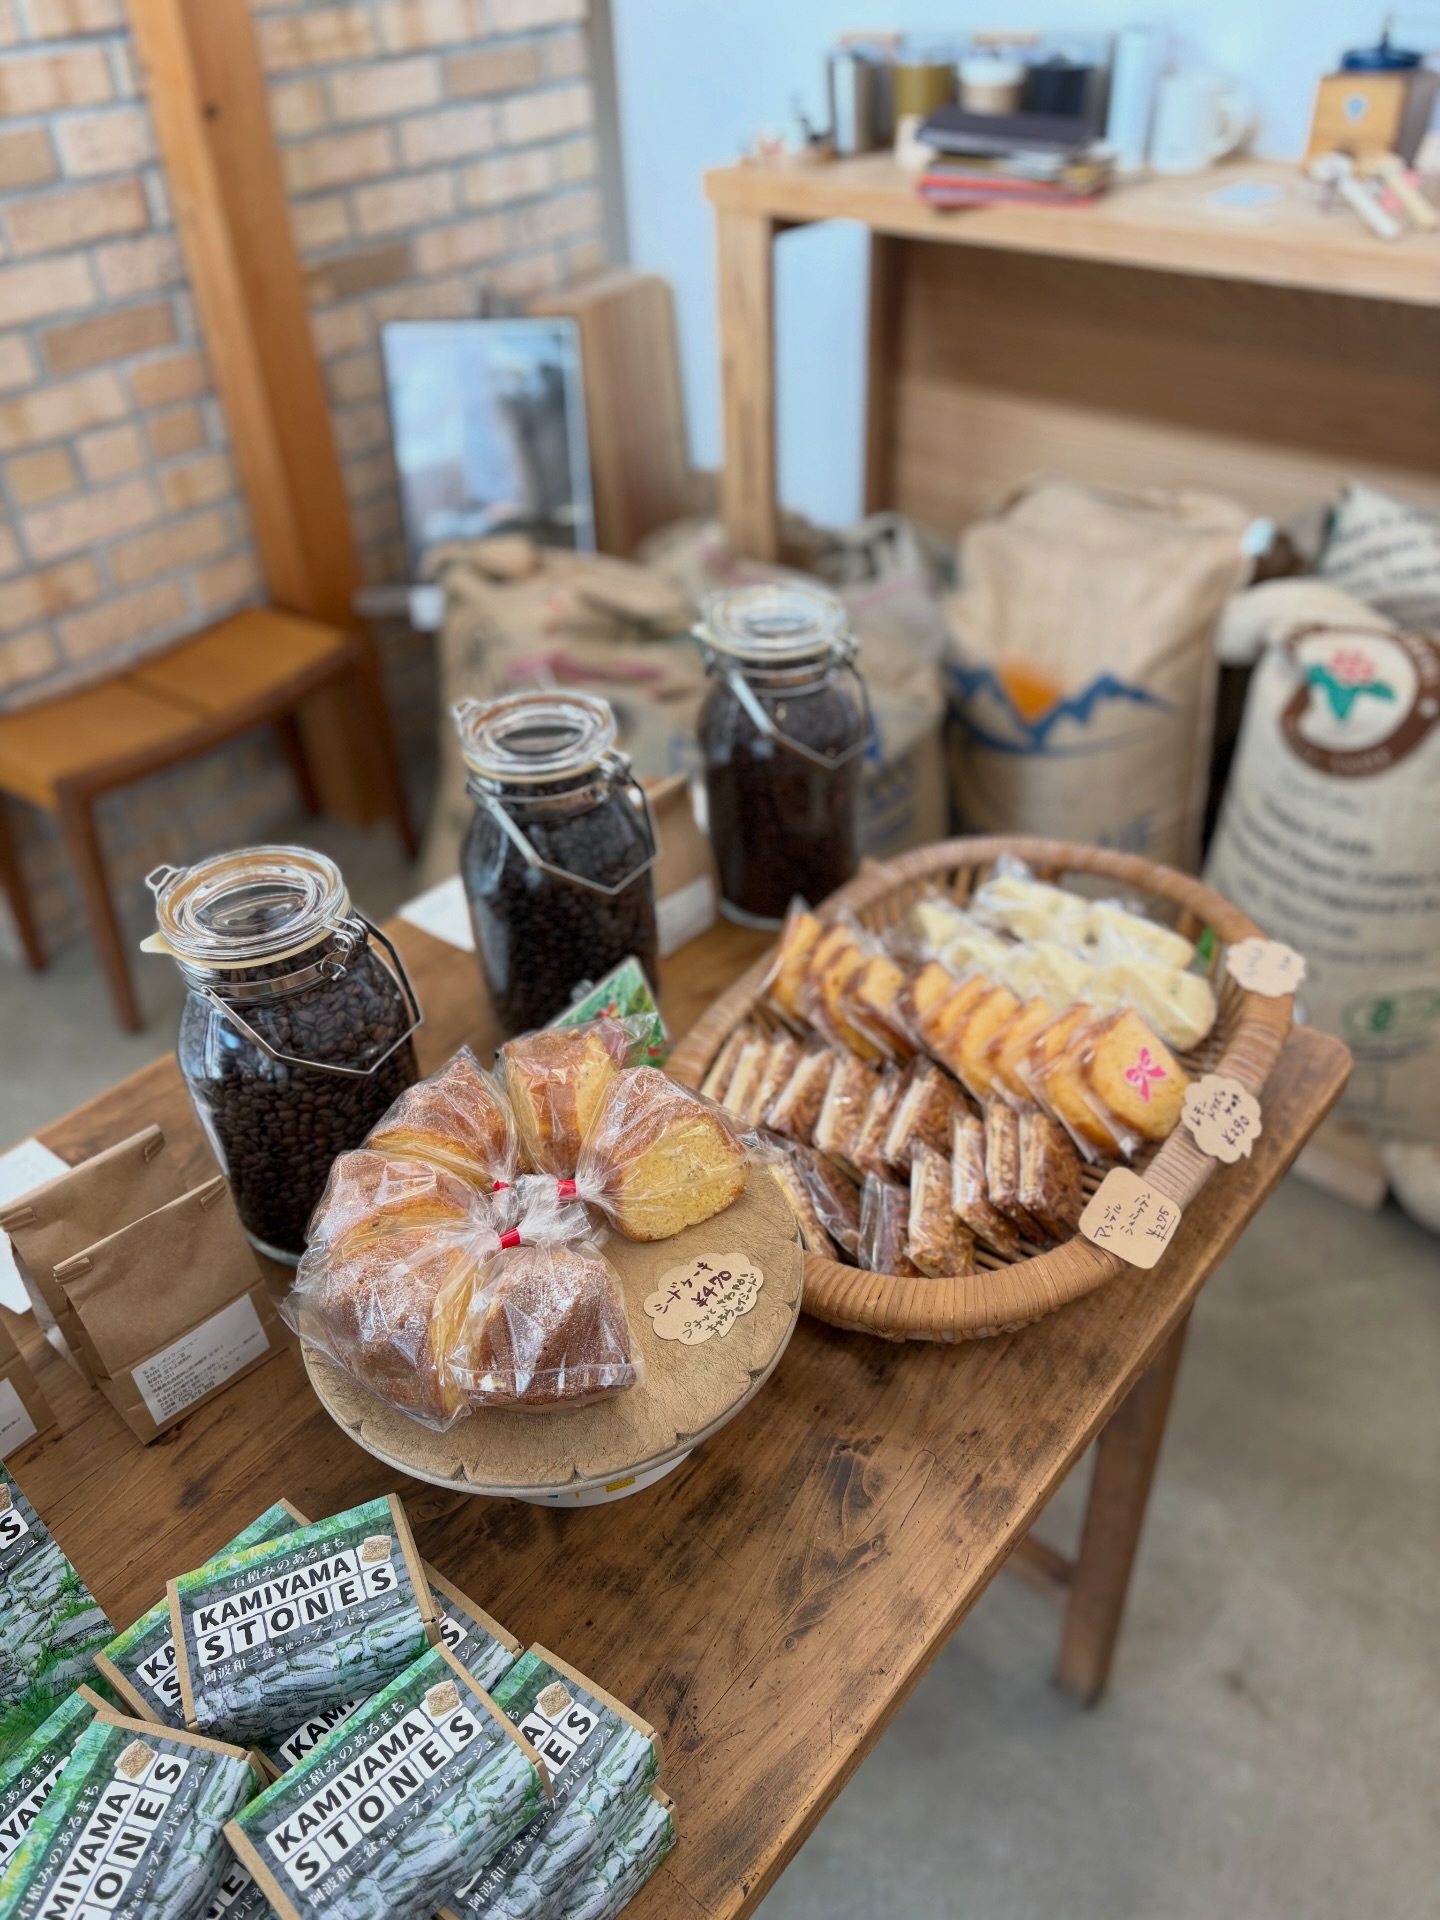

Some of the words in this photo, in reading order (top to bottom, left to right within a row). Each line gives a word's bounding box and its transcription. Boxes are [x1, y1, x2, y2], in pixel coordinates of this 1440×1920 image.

[1221, 1115, 1250, 1147] ¥290
[1146, 1205, 1169, 1242] ¥275
[653, 1261, 713, 1314] シードケーキ
[690, 1270, 732, 1307] ¥470
[200, 1557, 351, 1632] KAMIYAMA
[232, 1536, 345, 1590] 石積みのあるまち
[203, 1597, 403, 1686] 阿波和三盆を使ったブールドネージュ
[204, 1567, 392, 1661] STONES
[274, 1721, 425, 1853] KAMIYAMA
[296, 1702, 405, 1797] 石積みのあるまち
[78, 1761, 181, 1920] ONES
[295, 1715, 474, 1882] STONES
[308, 1740, 496, 1908] 阿波和三盆を使ったブールドネージュ
